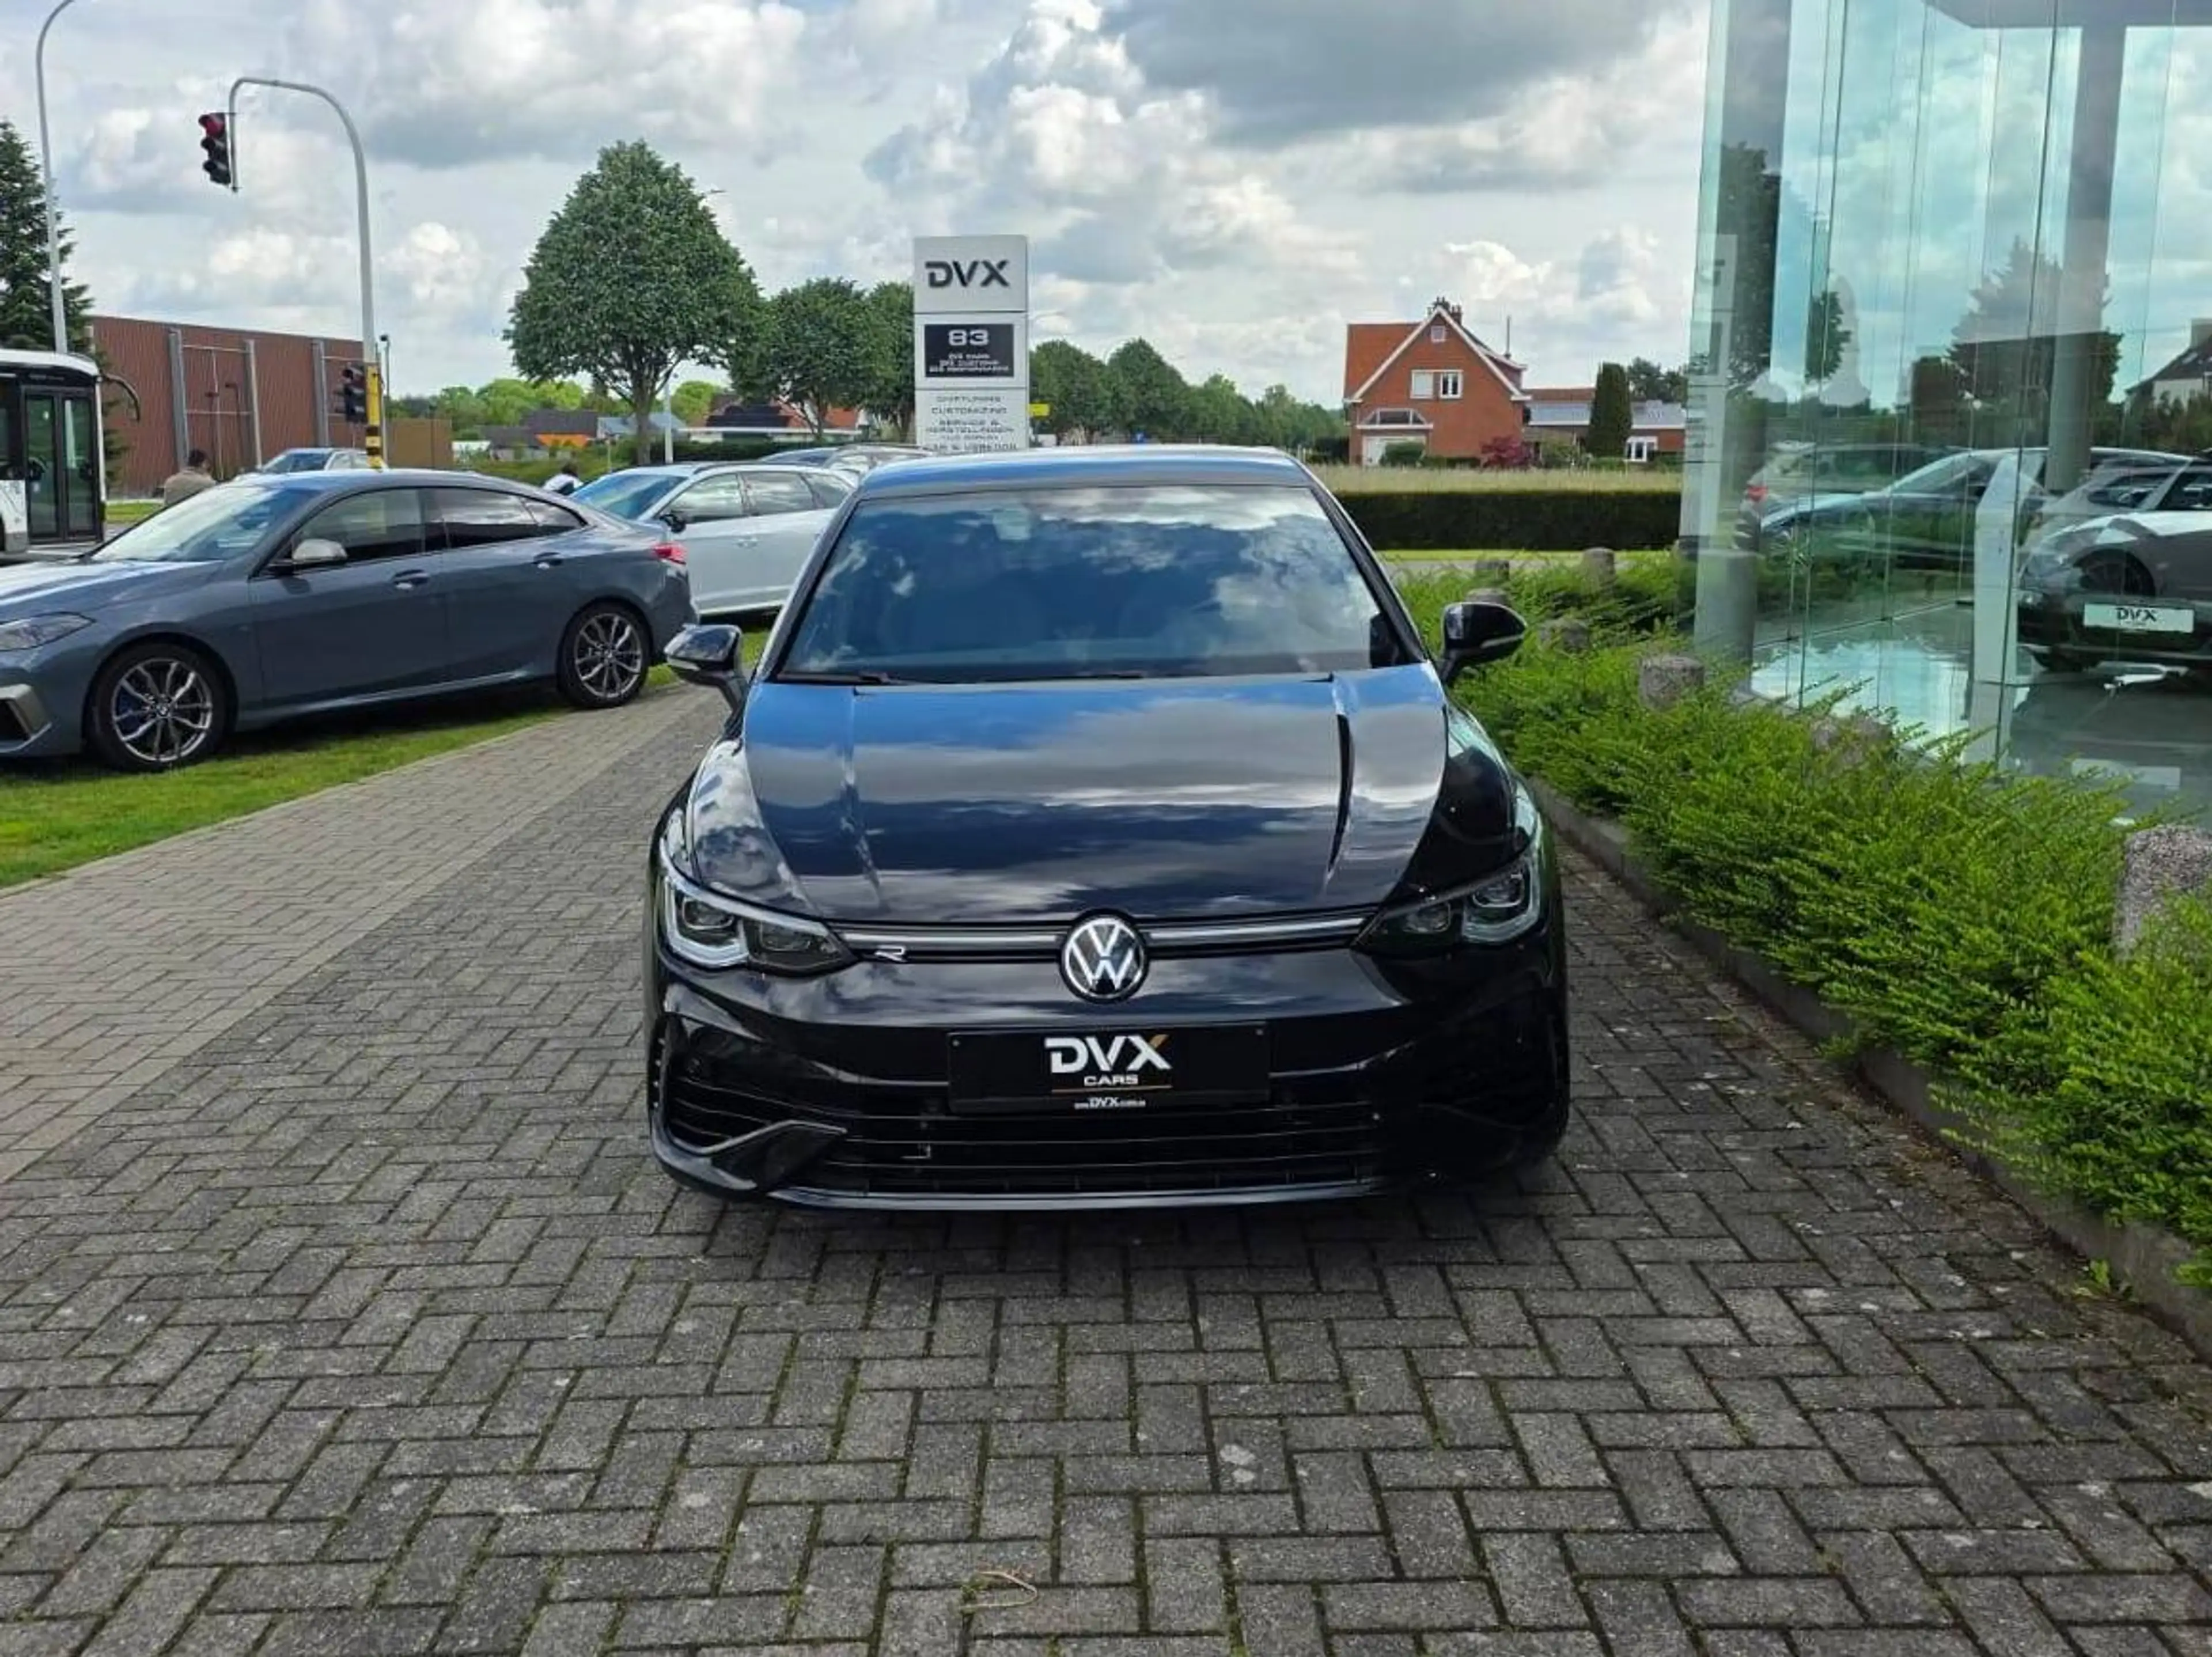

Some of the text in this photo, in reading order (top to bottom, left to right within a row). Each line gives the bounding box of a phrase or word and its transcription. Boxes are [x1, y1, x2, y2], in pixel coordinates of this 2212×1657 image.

[925, 260, 1010, 287] DVX
[948, 329, 989, 346] 83
[2116, 607, 2157, 623] DVX
[1045, 1034, 1172, 1074] DVX
[1084, 1075, 1138, 1086] CARS
